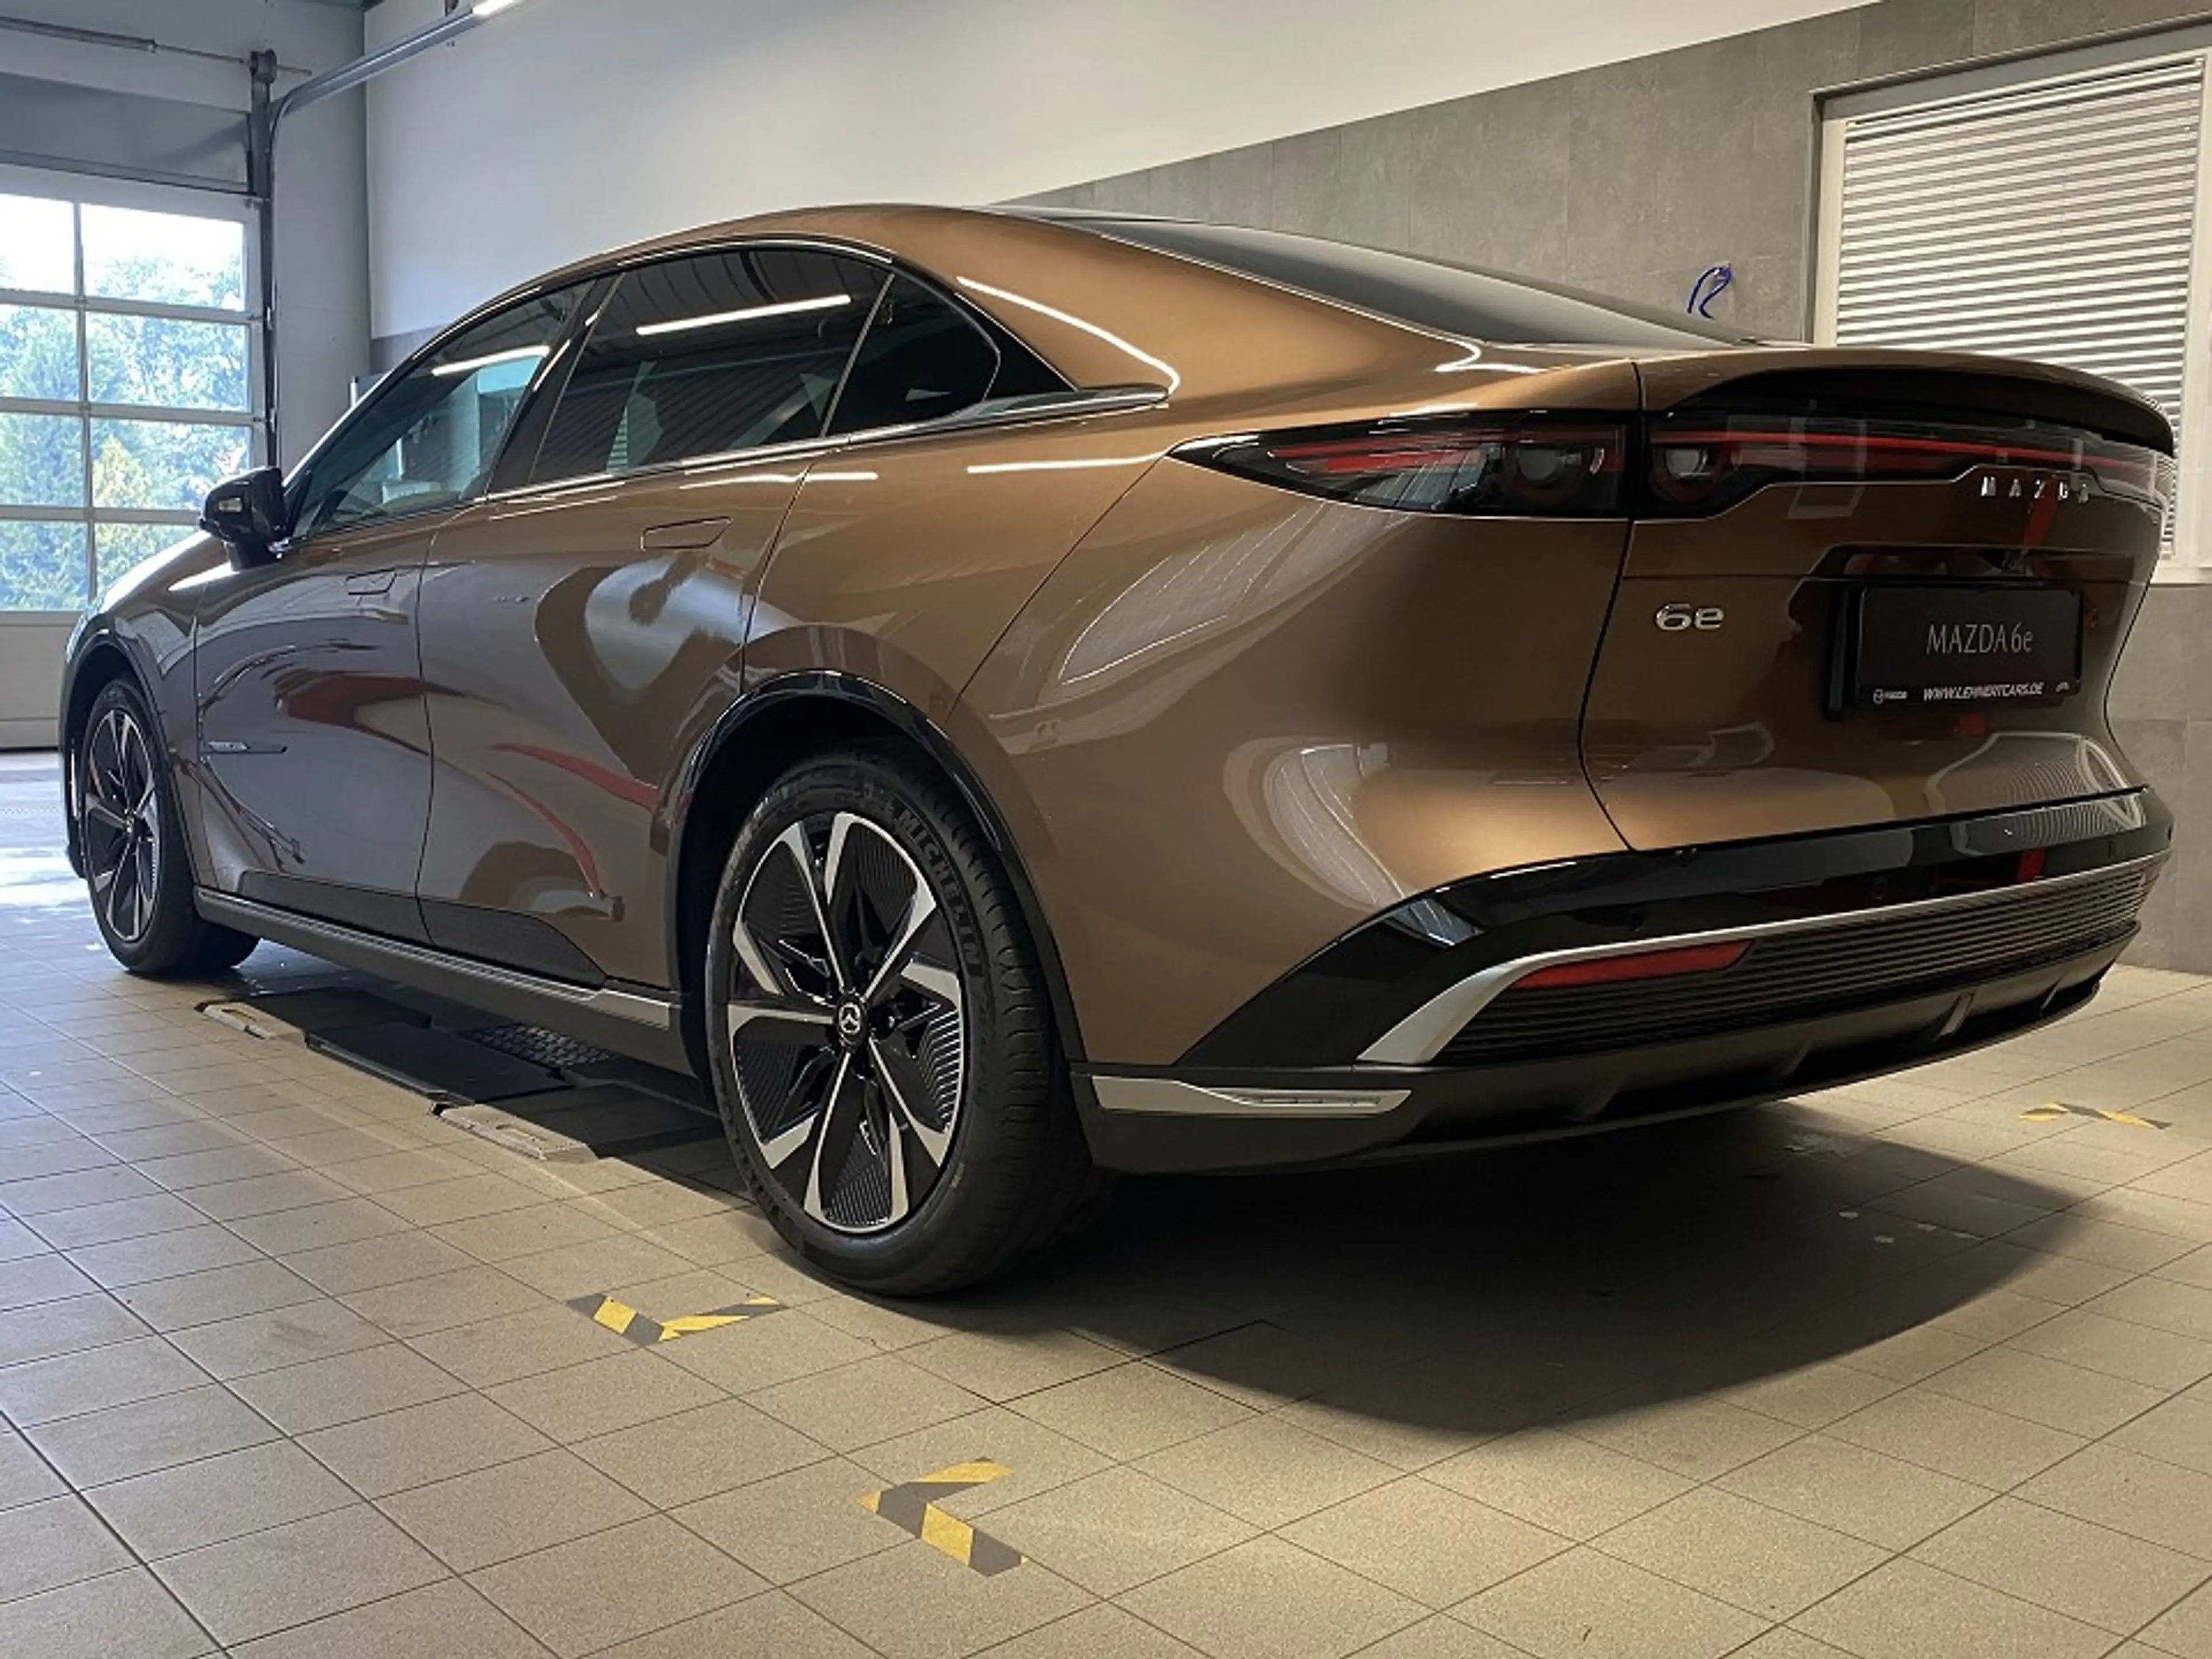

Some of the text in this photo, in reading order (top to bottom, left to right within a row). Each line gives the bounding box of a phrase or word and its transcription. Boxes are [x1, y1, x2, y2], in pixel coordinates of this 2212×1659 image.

[1980, 476, 2089, 503] MAZDA
[1655, 603, 1724, 631] 6e
[895, 809, 980, 964] MICHELIN
